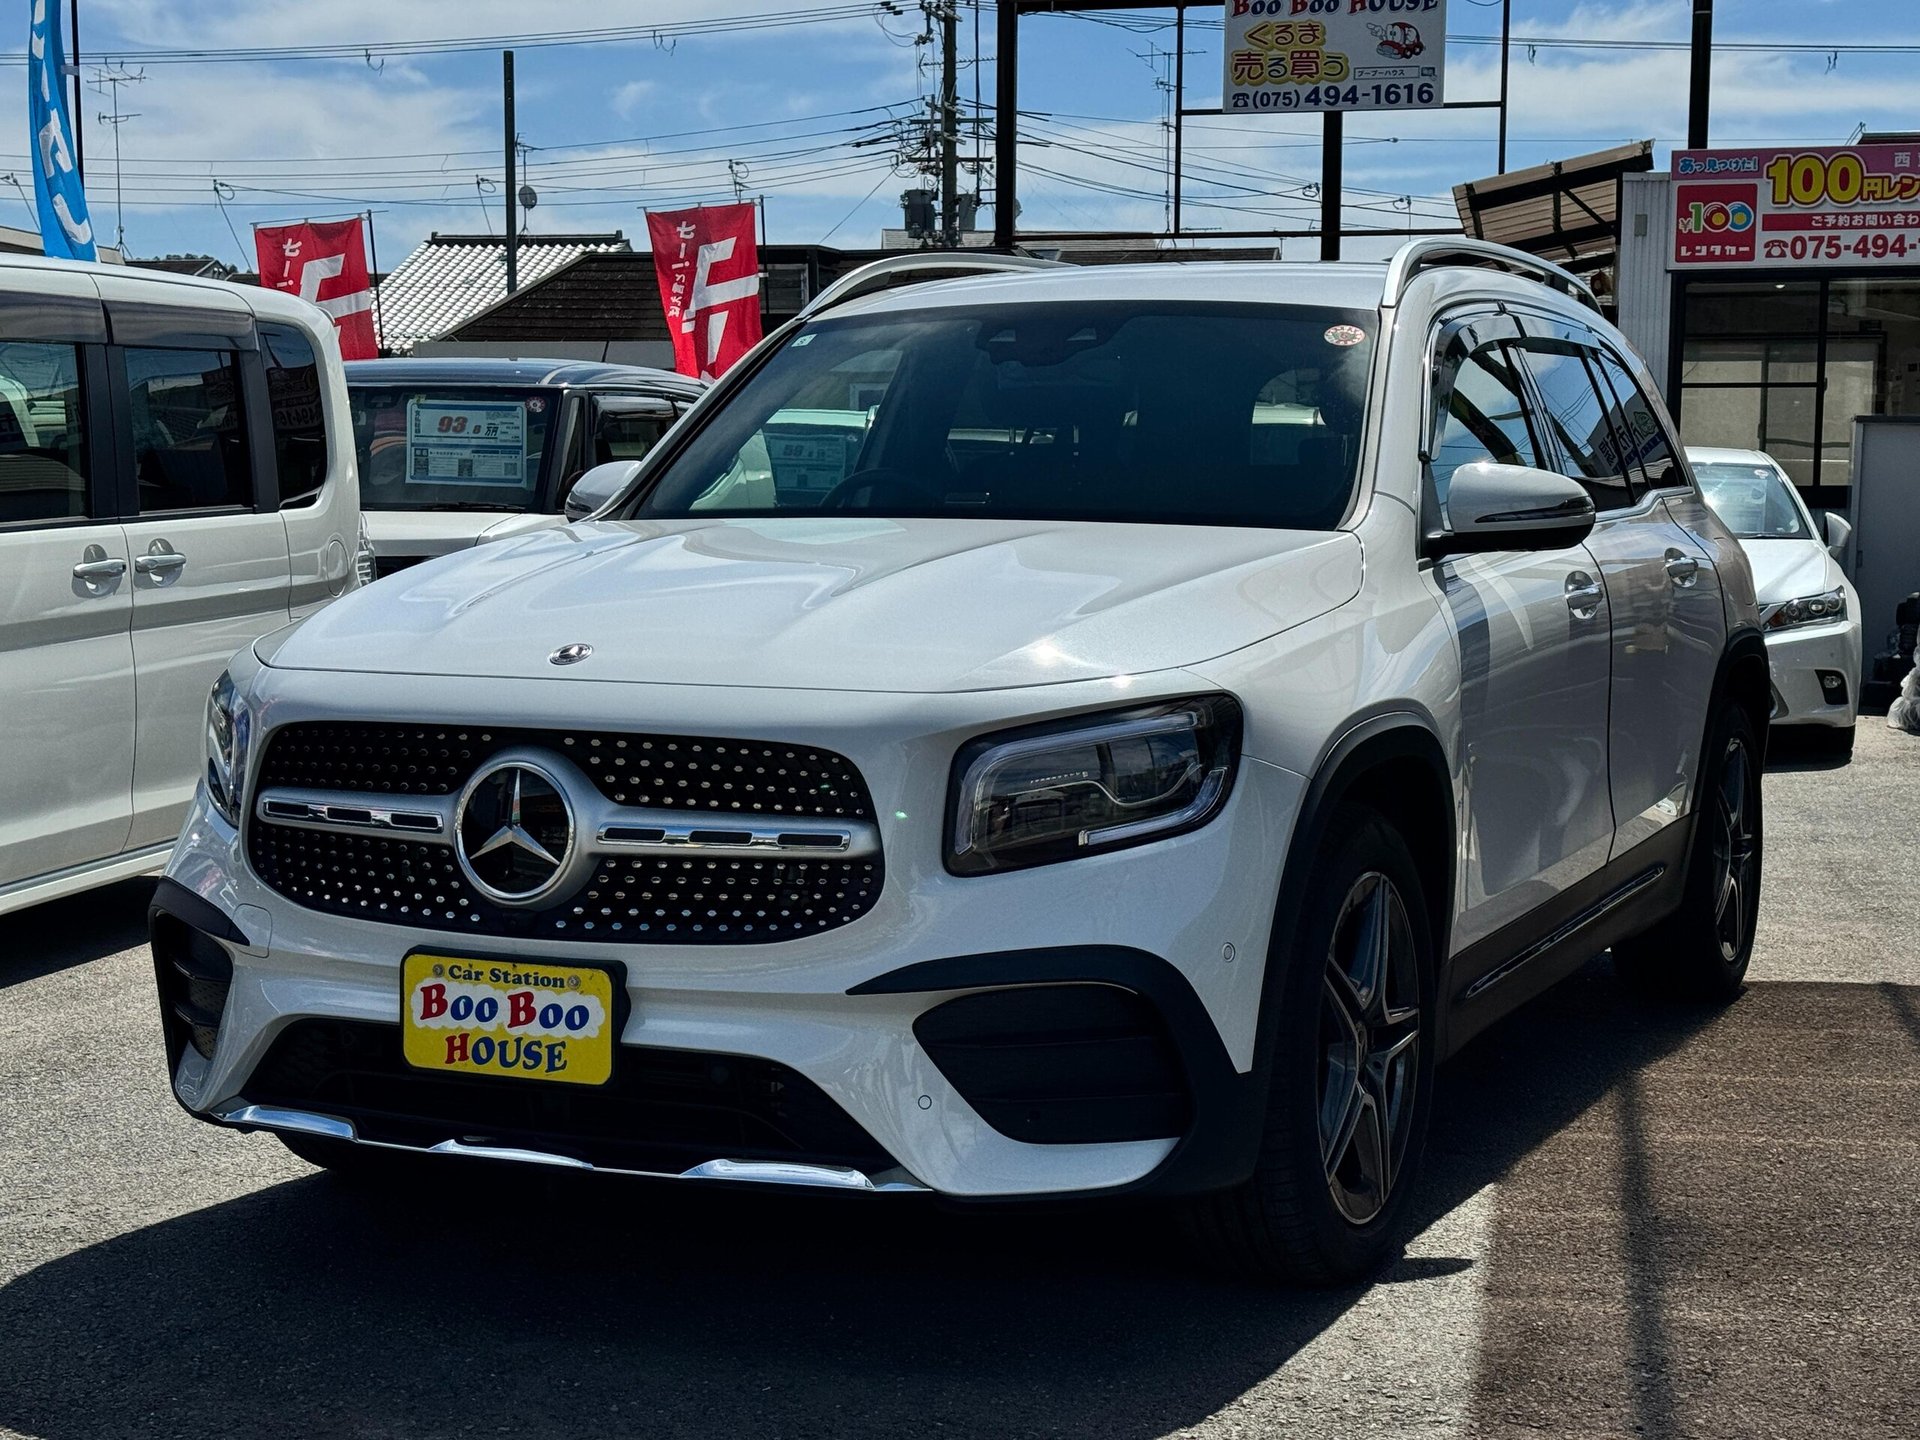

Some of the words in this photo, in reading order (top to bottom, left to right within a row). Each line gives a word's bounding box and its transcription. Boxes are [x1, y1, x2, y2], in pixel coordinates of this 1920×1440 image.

[1247, 22, 1321, 46] くるま
[1233, 50, 1344, 80] 売る買う
[1680, 245, 1750, 257] レンタカー
[1789, 233, 1920, 260] 075-494-
[448, 964, 484, 982] Car
[489, 967, 565, 989] Station
[445, 1032, 568, 1073] HOUSE
